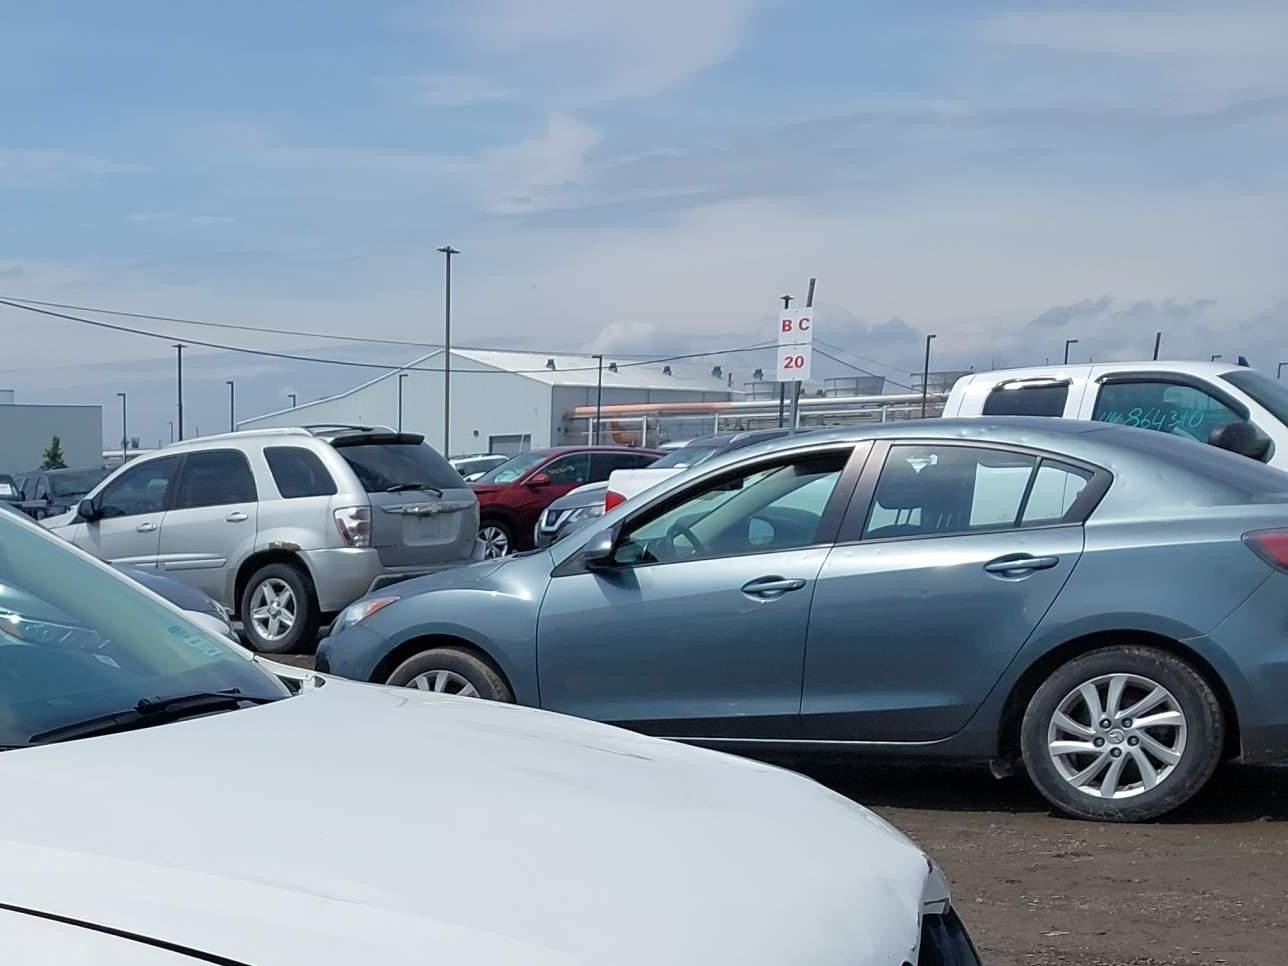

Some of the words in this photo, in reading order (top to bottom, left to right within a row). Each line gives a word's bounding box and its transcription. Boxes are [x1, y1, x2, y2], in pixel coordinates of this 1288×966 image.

[781, 319, 793, 332] B
[798, 318, 811, 331] C
[783, 355, 805, 369] 20
